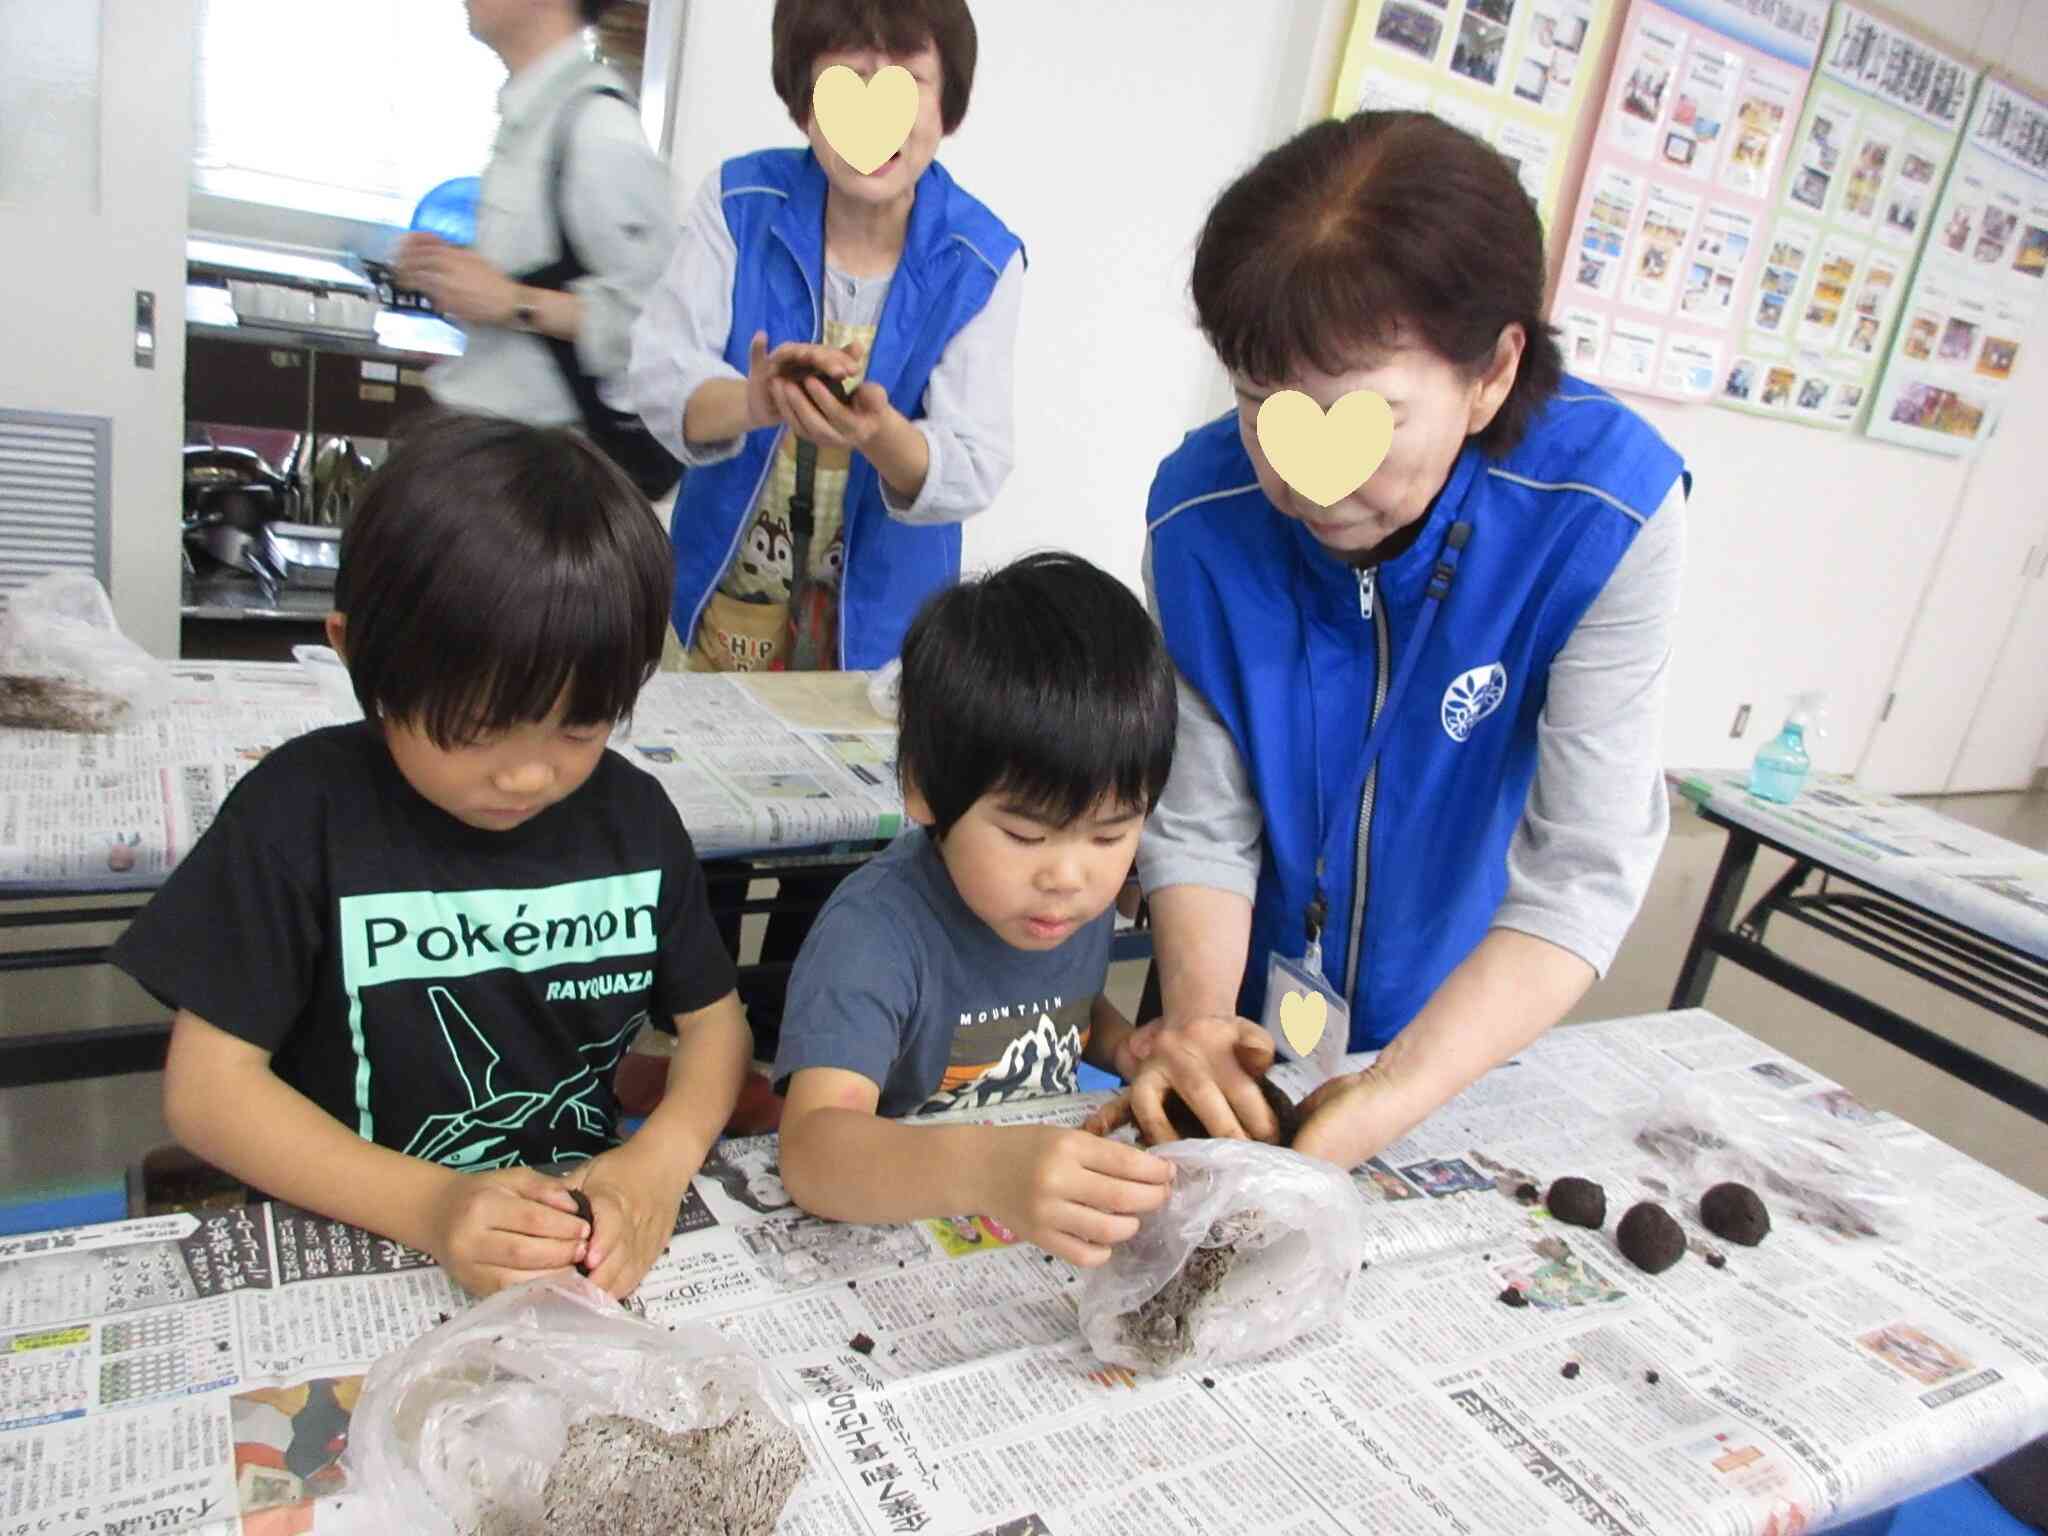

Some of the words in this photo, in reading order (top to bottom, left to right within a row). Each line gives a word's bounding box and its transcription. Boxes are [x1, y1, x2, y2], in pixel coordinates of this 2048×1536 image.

[364, 904, 657, 967] Pokémon
[545, 969, 653, 1001] RAYQUAZA
[960, 997, 1062, 1025] MOUNTAIN
